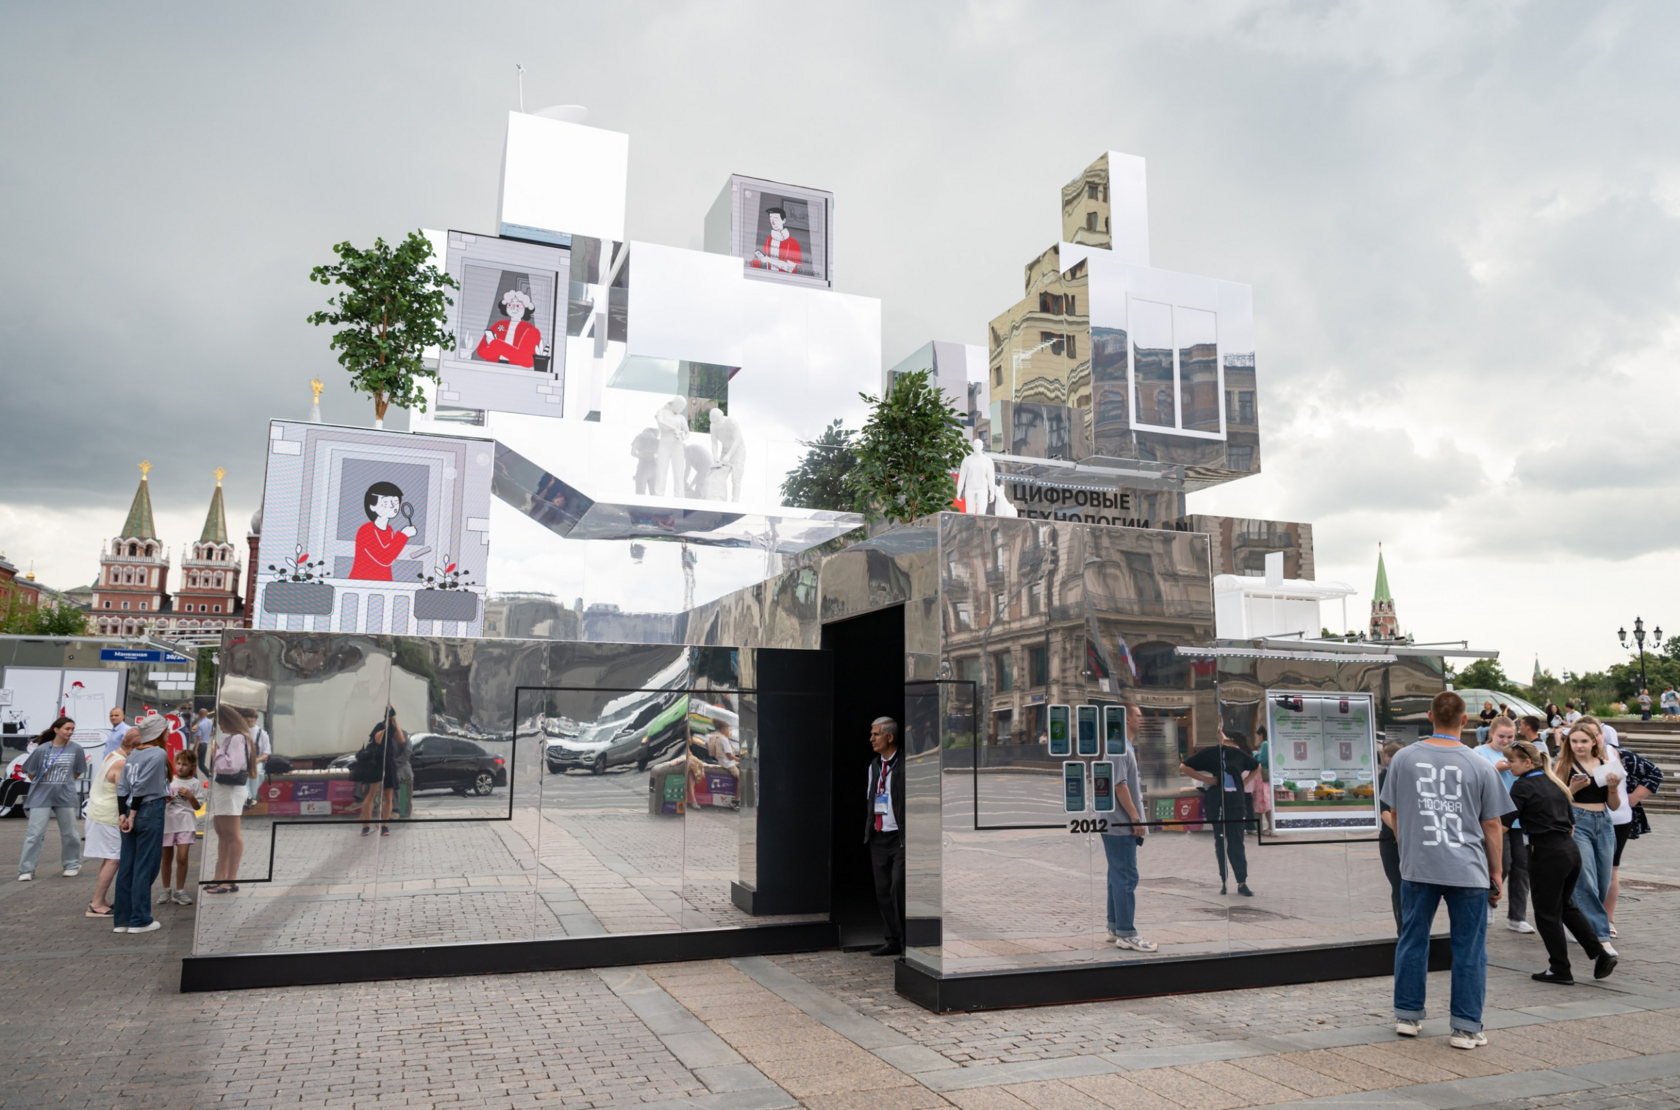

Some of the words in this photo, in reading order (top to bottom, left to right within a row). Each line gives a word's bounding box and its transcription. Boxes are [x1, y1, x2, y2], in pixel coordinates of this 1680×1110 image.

[1013, 484, 1130, 511] ЦИФРОВЫЕ
[1415, 762, 1462, 800] 20
[1417, 798, 1463, 813] МОСКВА
[1070, 818, 1109, 834] 2012
[1419, 810, 1466, 848] 30
